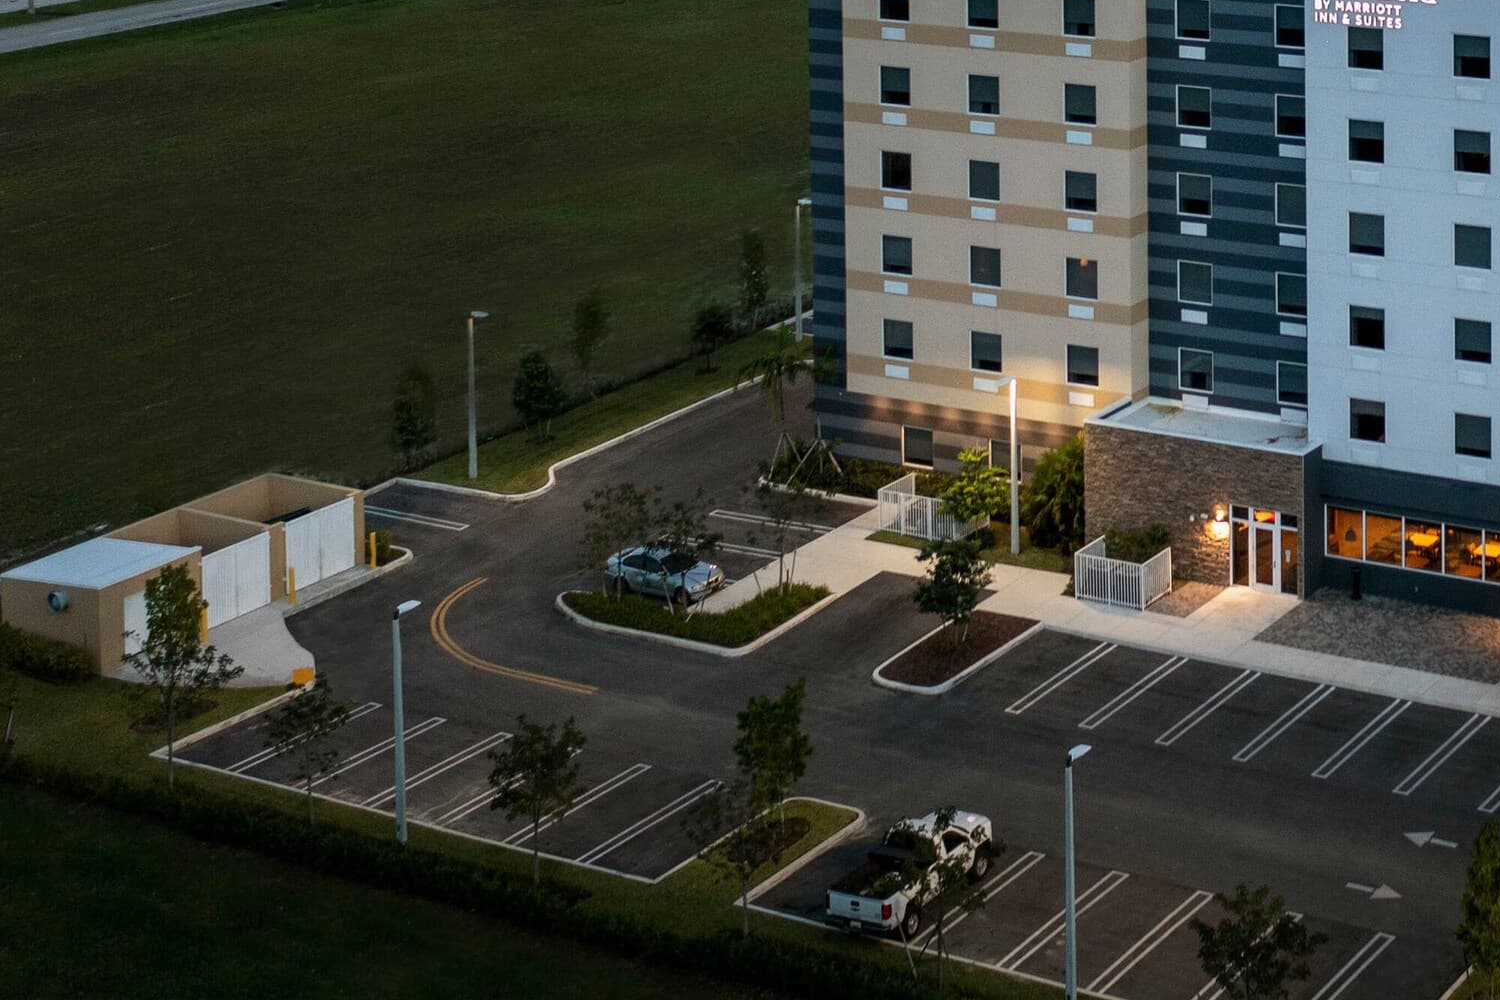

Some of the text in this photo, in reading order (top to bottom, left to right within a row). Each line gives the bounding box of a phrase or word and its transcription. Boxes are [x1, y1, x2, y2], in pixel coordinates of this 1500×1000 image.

[1335, 0, 1402, 16] MARRIOTT
[1314, 12, 1402, 30] INN & SUITES
